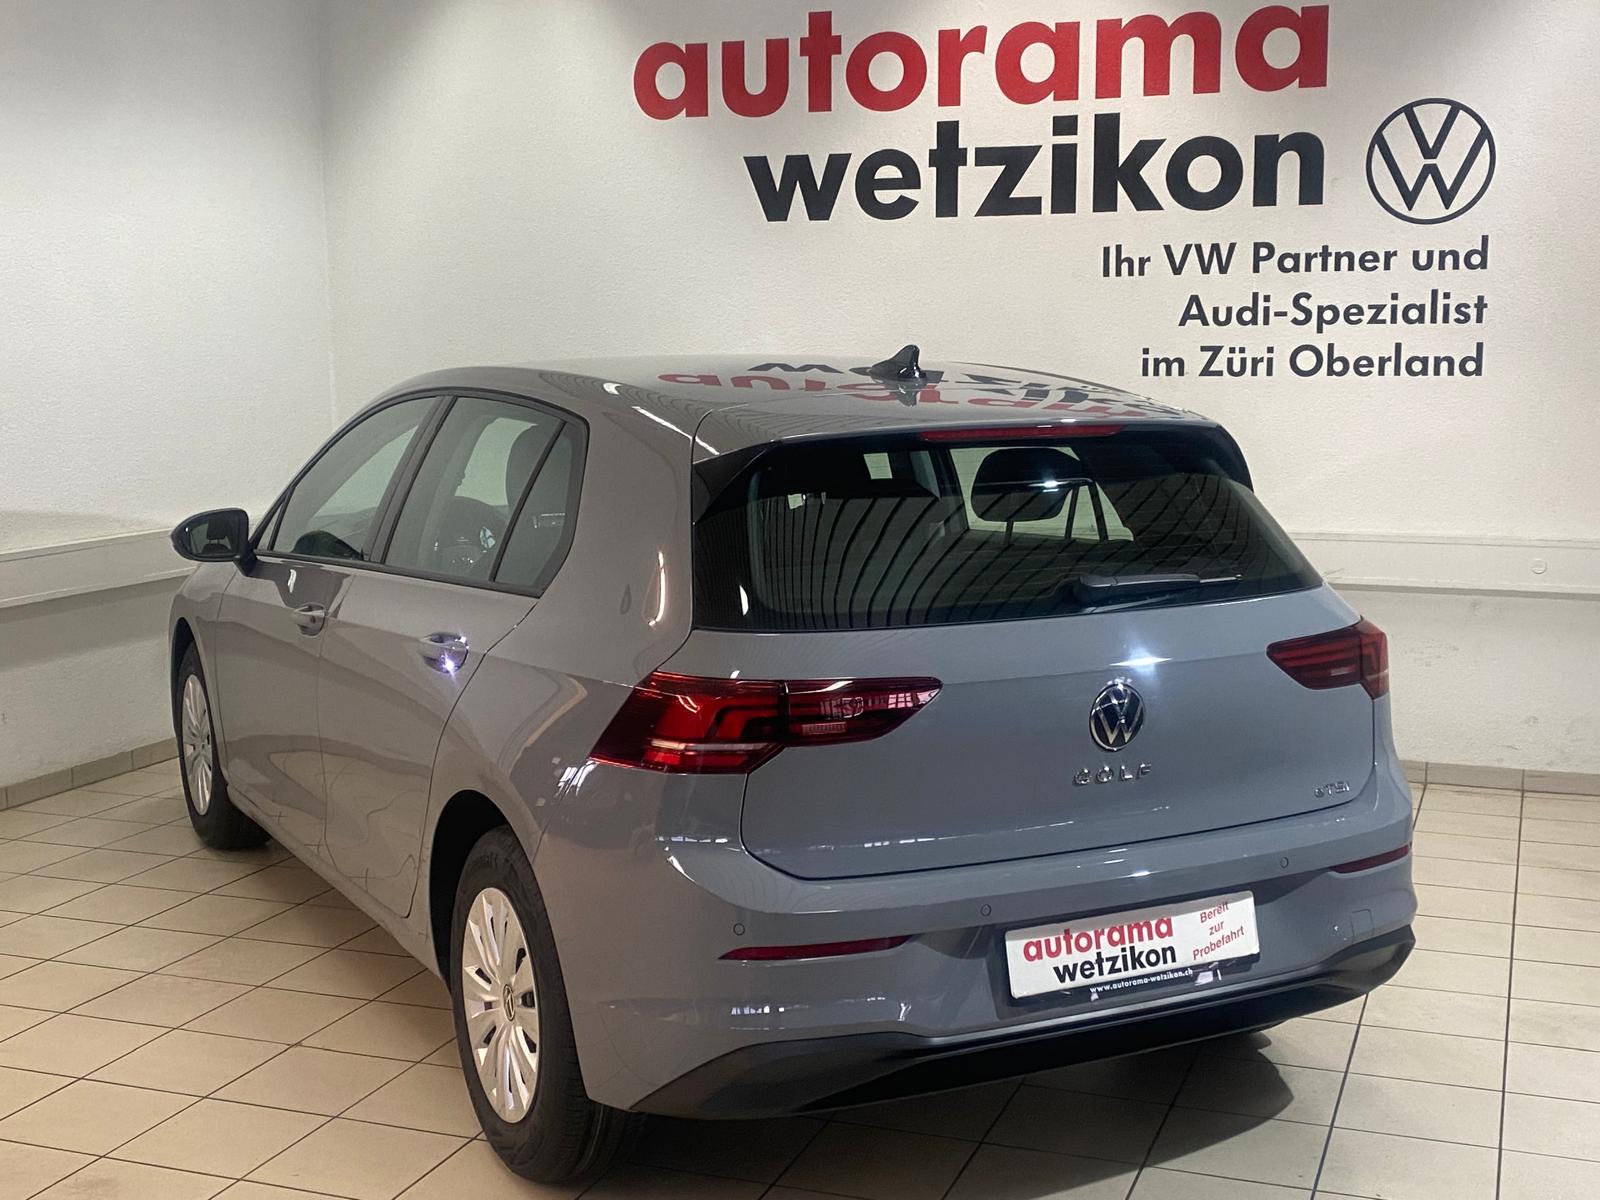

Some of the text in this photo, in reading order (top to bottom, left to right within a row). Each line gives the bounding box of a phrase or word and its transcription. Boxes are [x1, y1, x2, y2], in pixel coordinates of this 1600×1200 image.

[633, 6, 1328, 120] autorama
[743, 112, 1326, 223] wetzikon
[1102, 234, 1489, 278] Ihr VW Partner und
[1178, 288, 1488, 334] Audi-Spezialist
[1141, 341, 1484, 378] im Züri Oberland
[1074, 762, 1152, 785] GOLF
[1200, 901, 1229, 923] Bereit
[1209, 921, 1224, 936] zur
[1023, 917, 1174, 962] autorama
[1192, 925, 1244, 960] Probefahrt
[1053, 945, 1177, 983] wetzikon
[1089, 967, 1194, 993] www.autorama-wetzikon.ch
